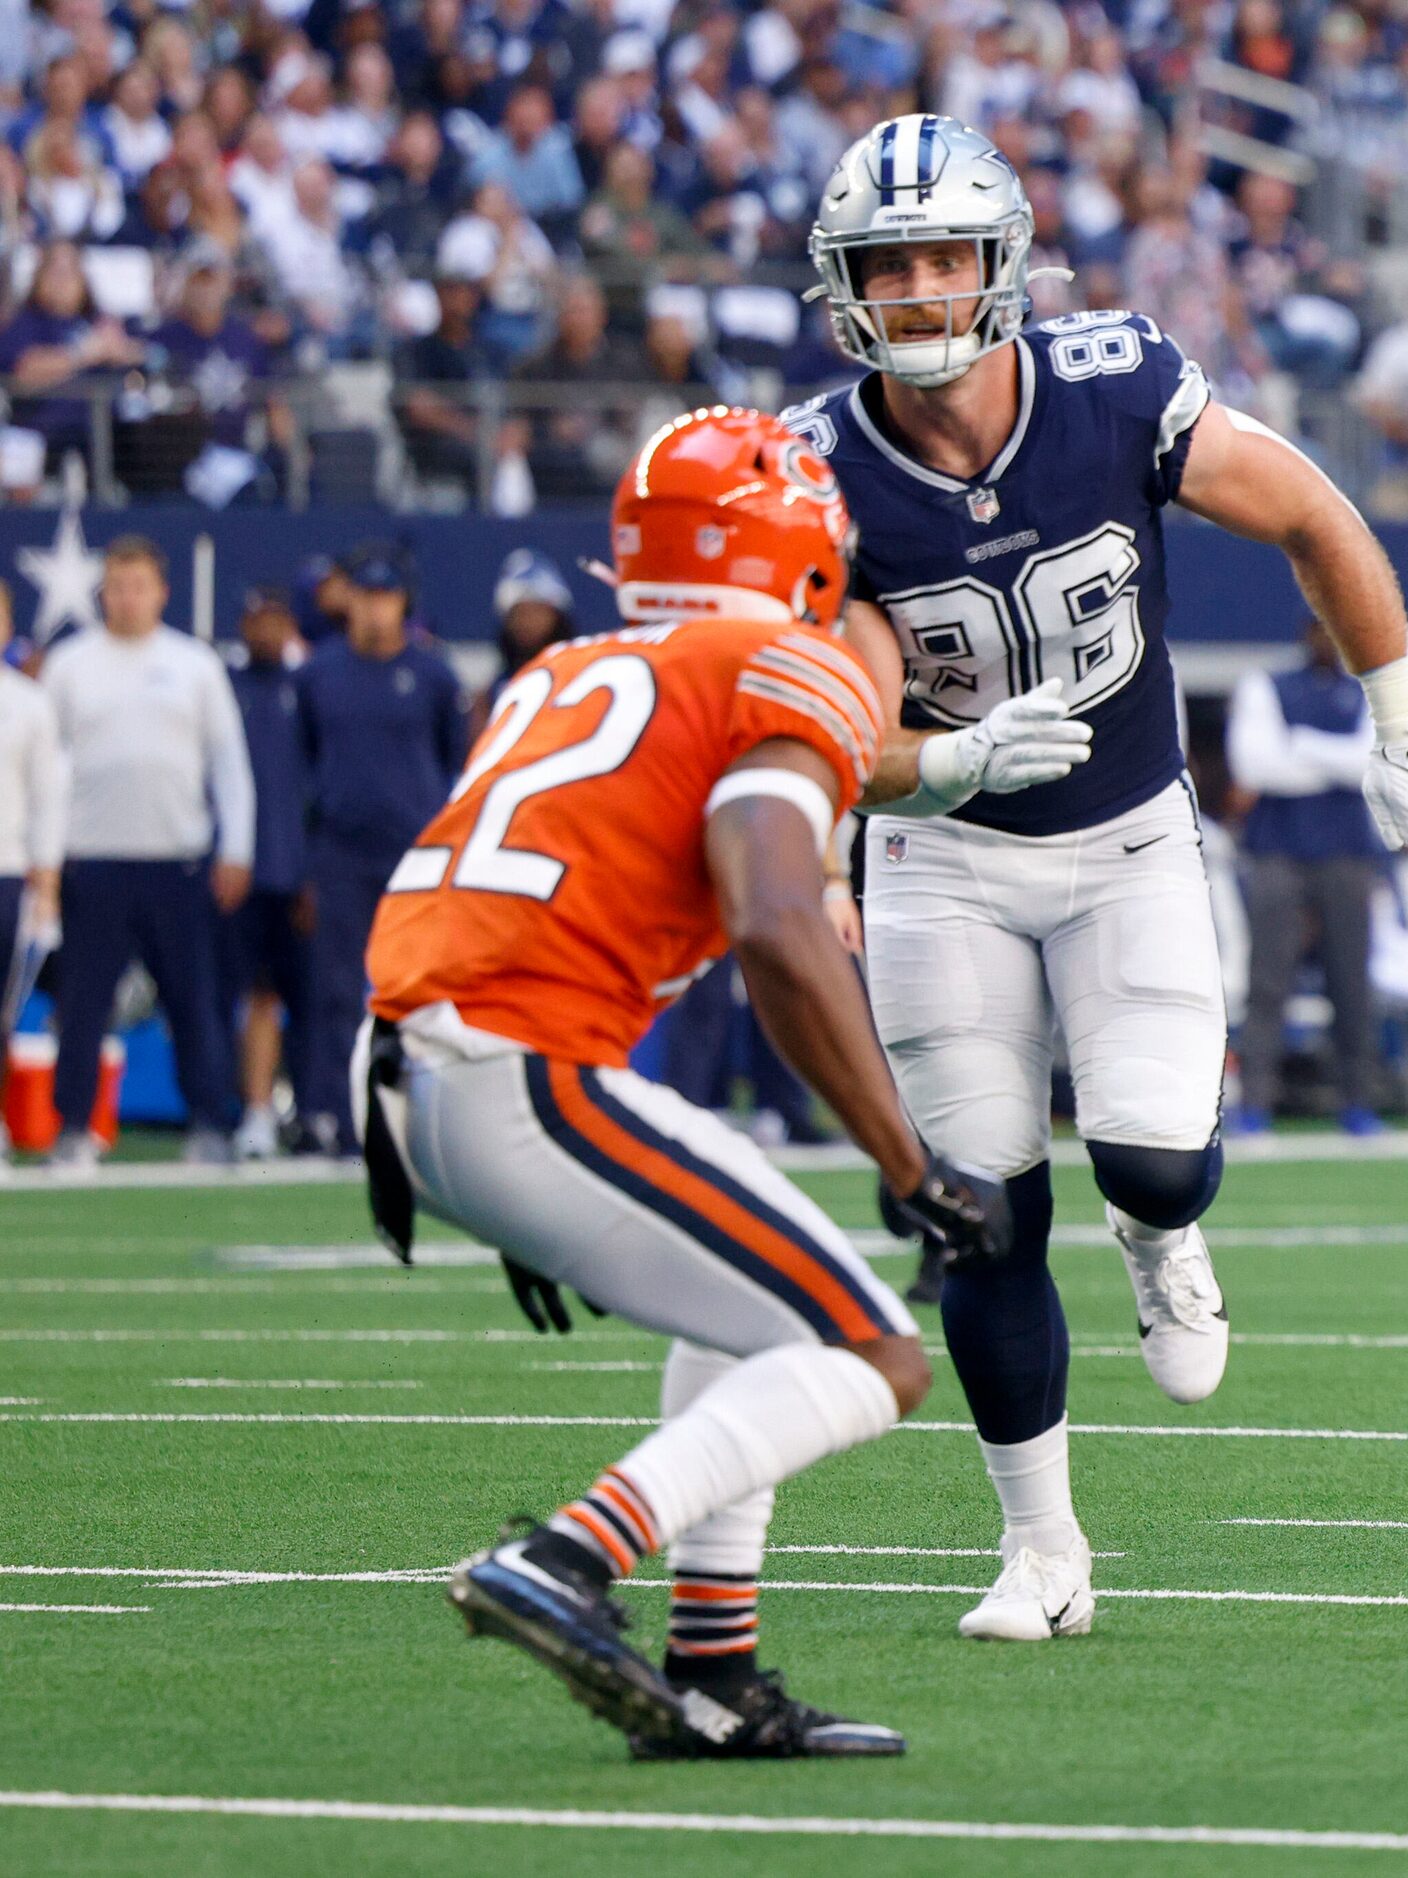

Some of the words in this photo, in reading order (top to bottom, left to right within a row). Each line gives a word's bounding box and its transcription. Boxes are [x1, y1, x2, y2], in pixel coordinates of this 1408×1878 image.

[879, 520, 1146, 729] 86
[965, 529, 1041, 564] COWBOYS
[386, 654, 657, 902] 22
